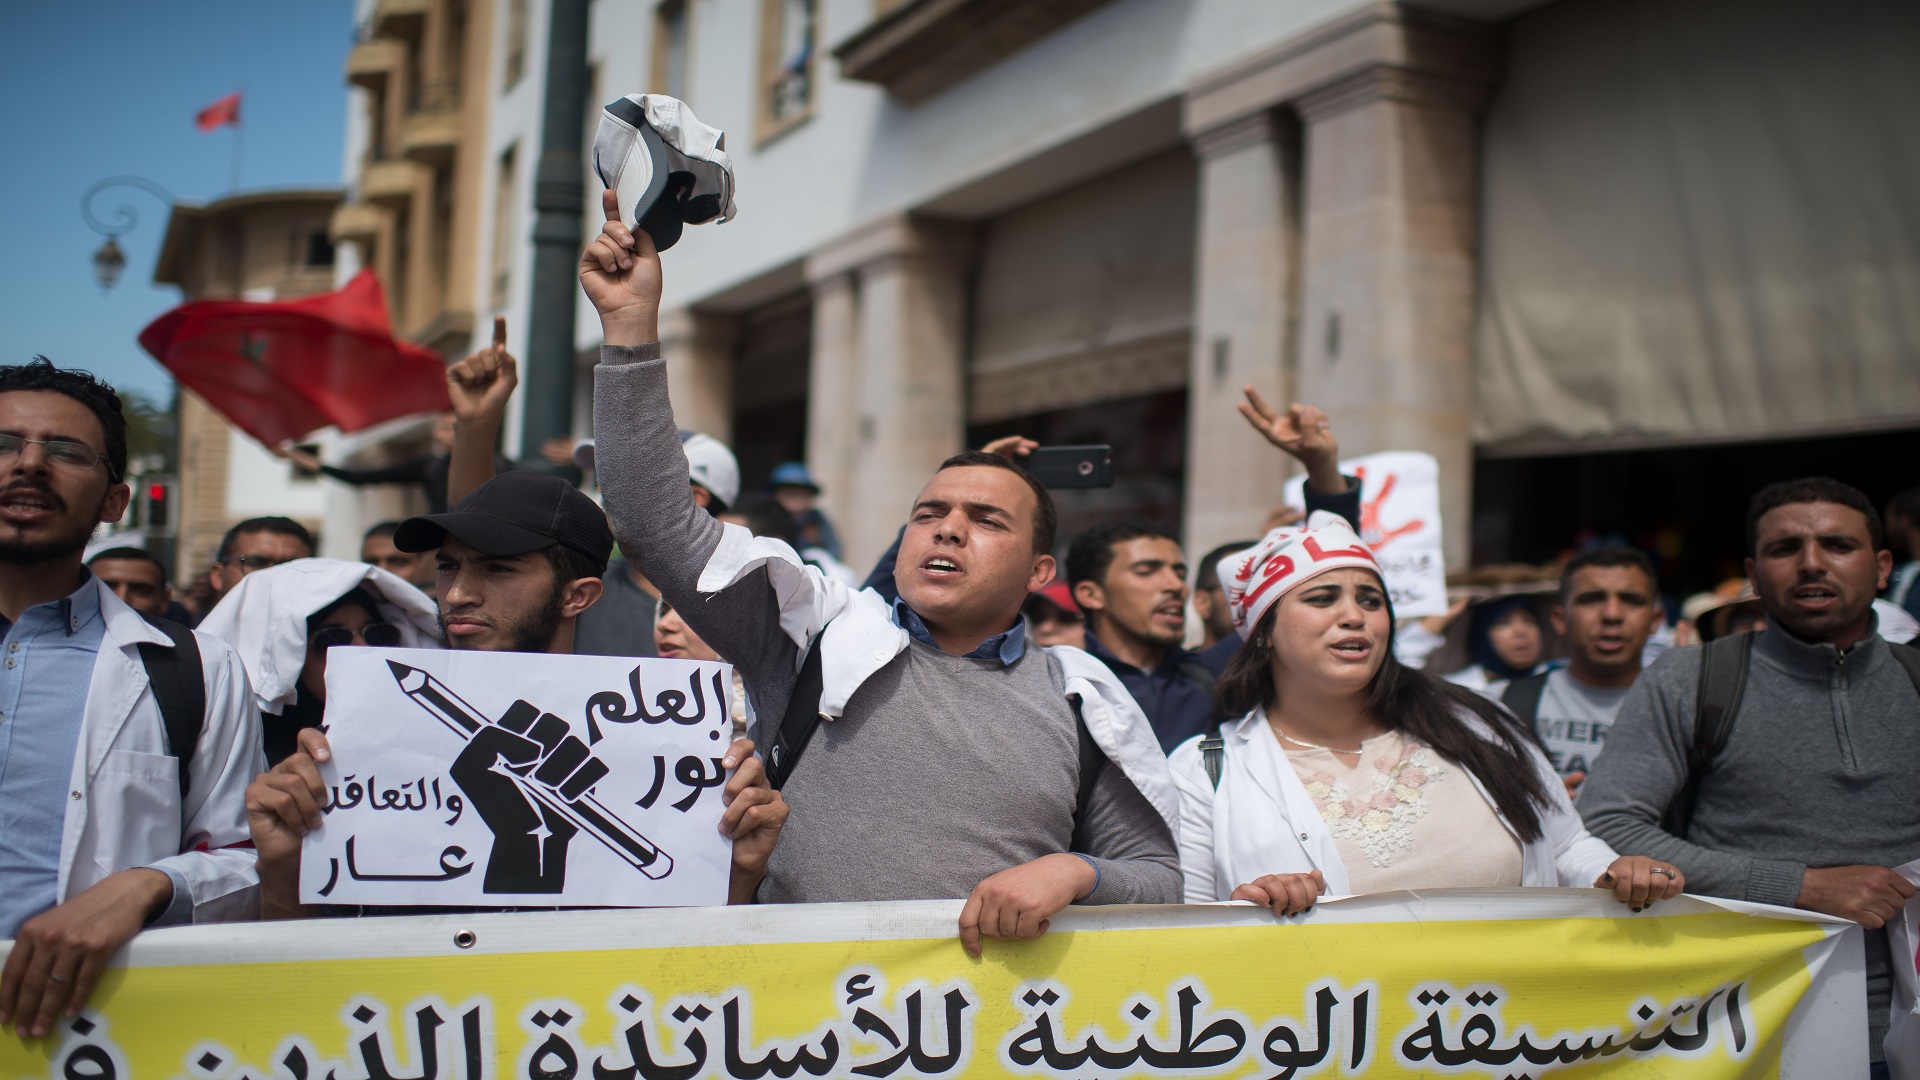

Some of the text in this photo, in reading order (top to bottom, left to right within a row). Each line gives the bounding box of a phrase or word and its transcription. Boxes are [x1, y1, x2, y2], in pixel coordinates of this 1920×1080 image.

[585, 664, 727, 747] العلم
[322, 773, 464, 826] والتعاقد
[634, 729, 727, 813] نور
[528, 973, 971, 1080] للأساتذة
[1008, 985, 1369, 1080] الوطنية
